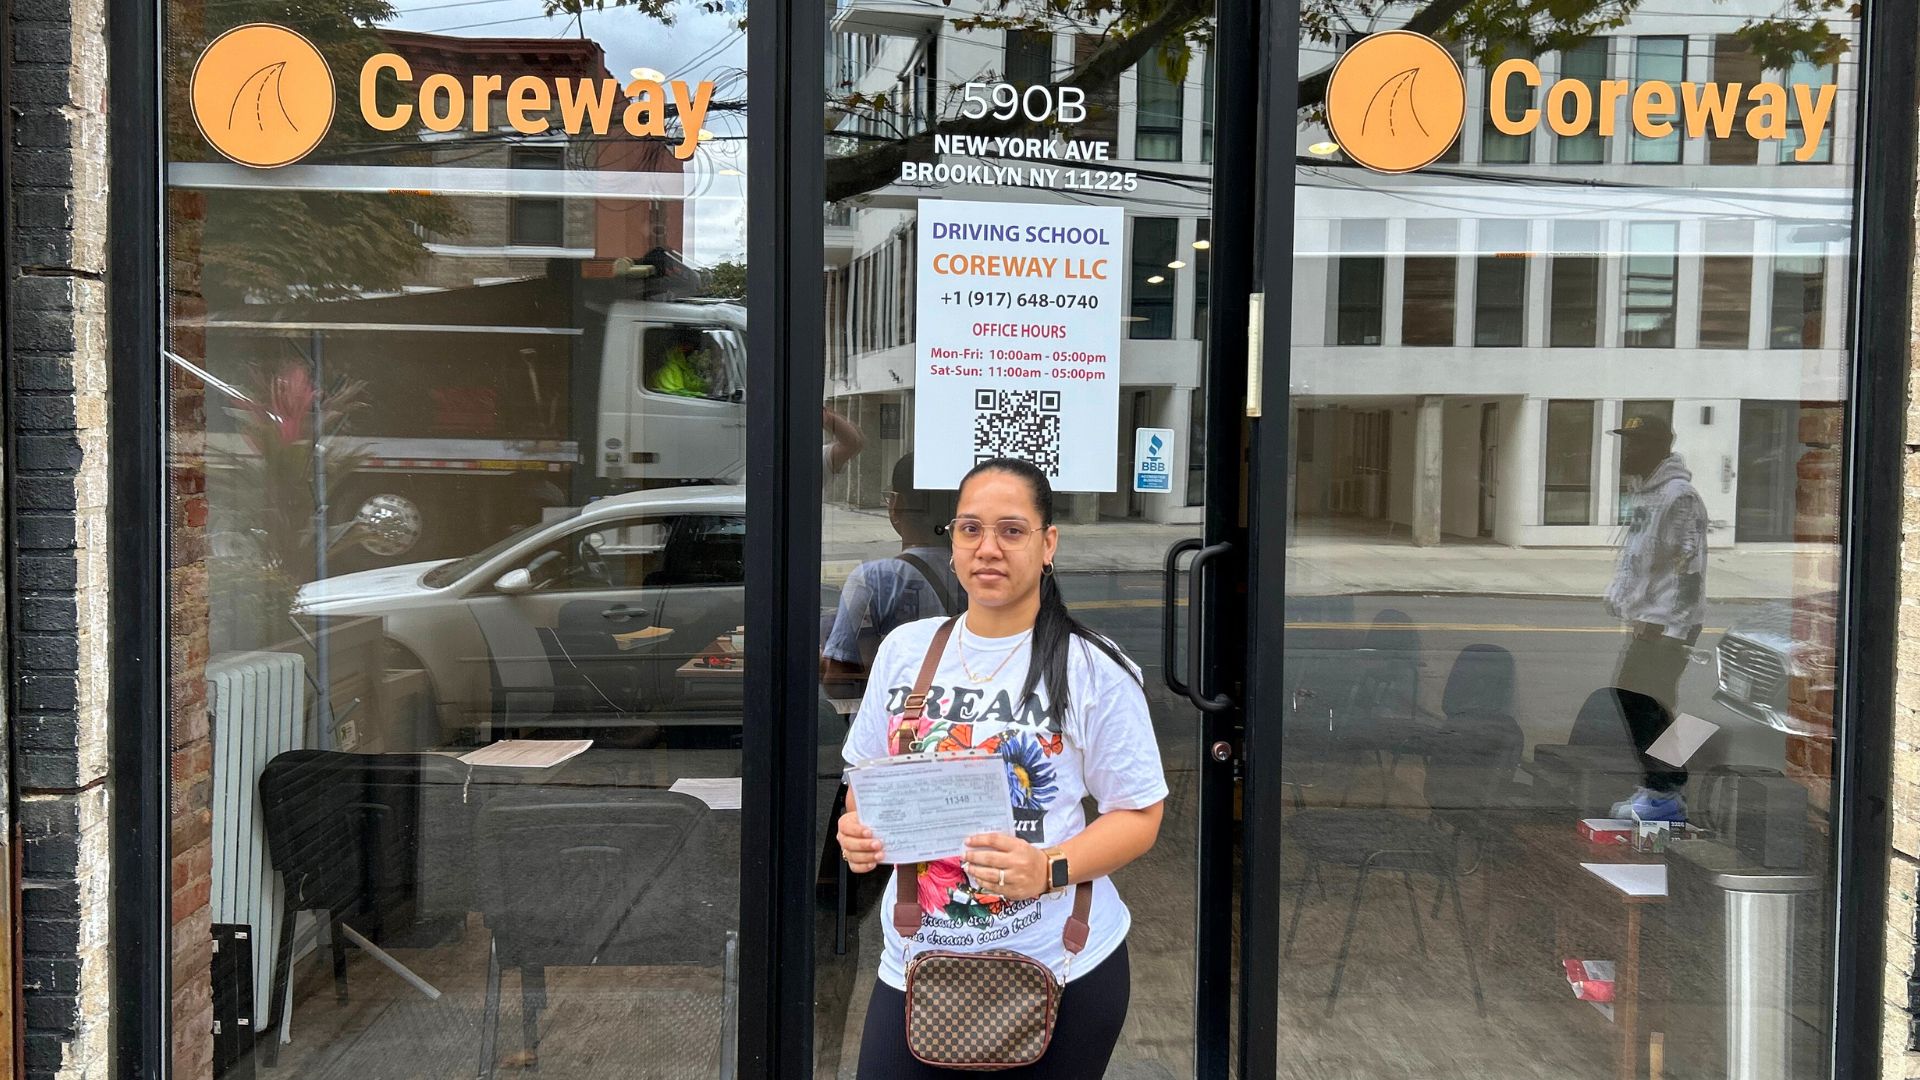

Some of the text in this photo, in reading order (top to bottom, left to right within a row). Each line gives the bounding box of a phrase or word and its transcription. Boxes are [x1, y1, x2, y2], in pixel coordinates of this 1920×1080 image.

[359, 52, 717, 161] Coreway
[962, 82, 1087, 123] 590B
[1489, 57, 1838, 161] Coreway
[934, 134, 1110, 161] NEW YORK AVE
[901, 161, 1138, 192] BROOKLYN NY 11225
[932, 222, 1110, 245] DRIVING SCHOOL
[932, 253, 1108, 280] COREWAY LLC
[940, 291, 1099, 309] +1 (917) 648-0740
[972, 323, 1067, 339] OFFICE HOURS
[930, 347, 984, 360] Mon-Fri:
[990, 349, 1042, 361] 10:00am
[1052, 351, 1106, 365] 05:00pm
[930, 365, 983, 377] Sat-Sun:
[988, 366, 1041, 379] 11:00am
[1051, 368, 1106, 381] 05:00pm
[1141, 462, 1165, 471] BBB
[927, 930, 973, 945] dreams
[977, 926, 1009, 944] come
[1012, 902, 1042, 933] true!
